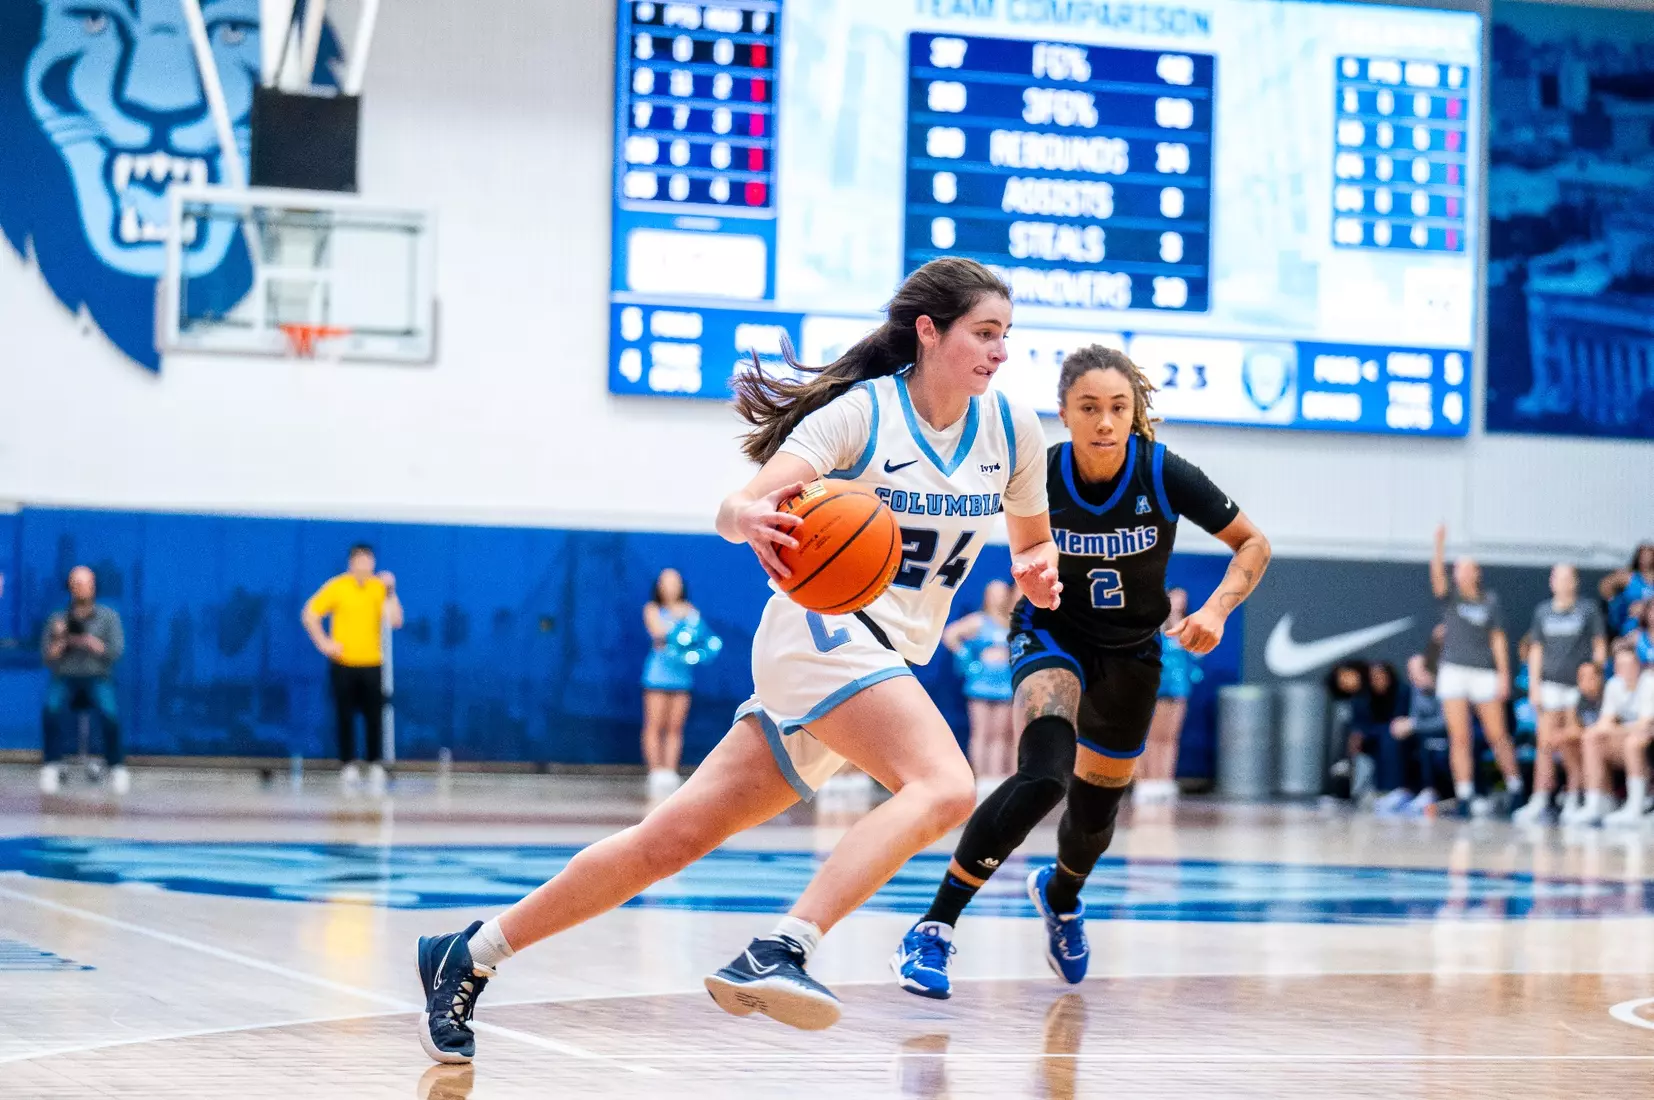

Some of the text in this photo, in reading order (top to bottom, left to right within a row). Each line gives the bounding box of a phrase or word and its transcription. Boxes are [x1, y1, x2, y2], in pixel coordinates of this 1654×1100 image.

[1004, 0, 1213, 37] COMPARISON
[1008, 220, 1106, 264] STEALS
[980, 464, 994, 474] Ivy
[892, 526, 977, 591] 24
[1051, 525, 1158, 561] Memphis
[1087, 568, 1125, 609] 2
